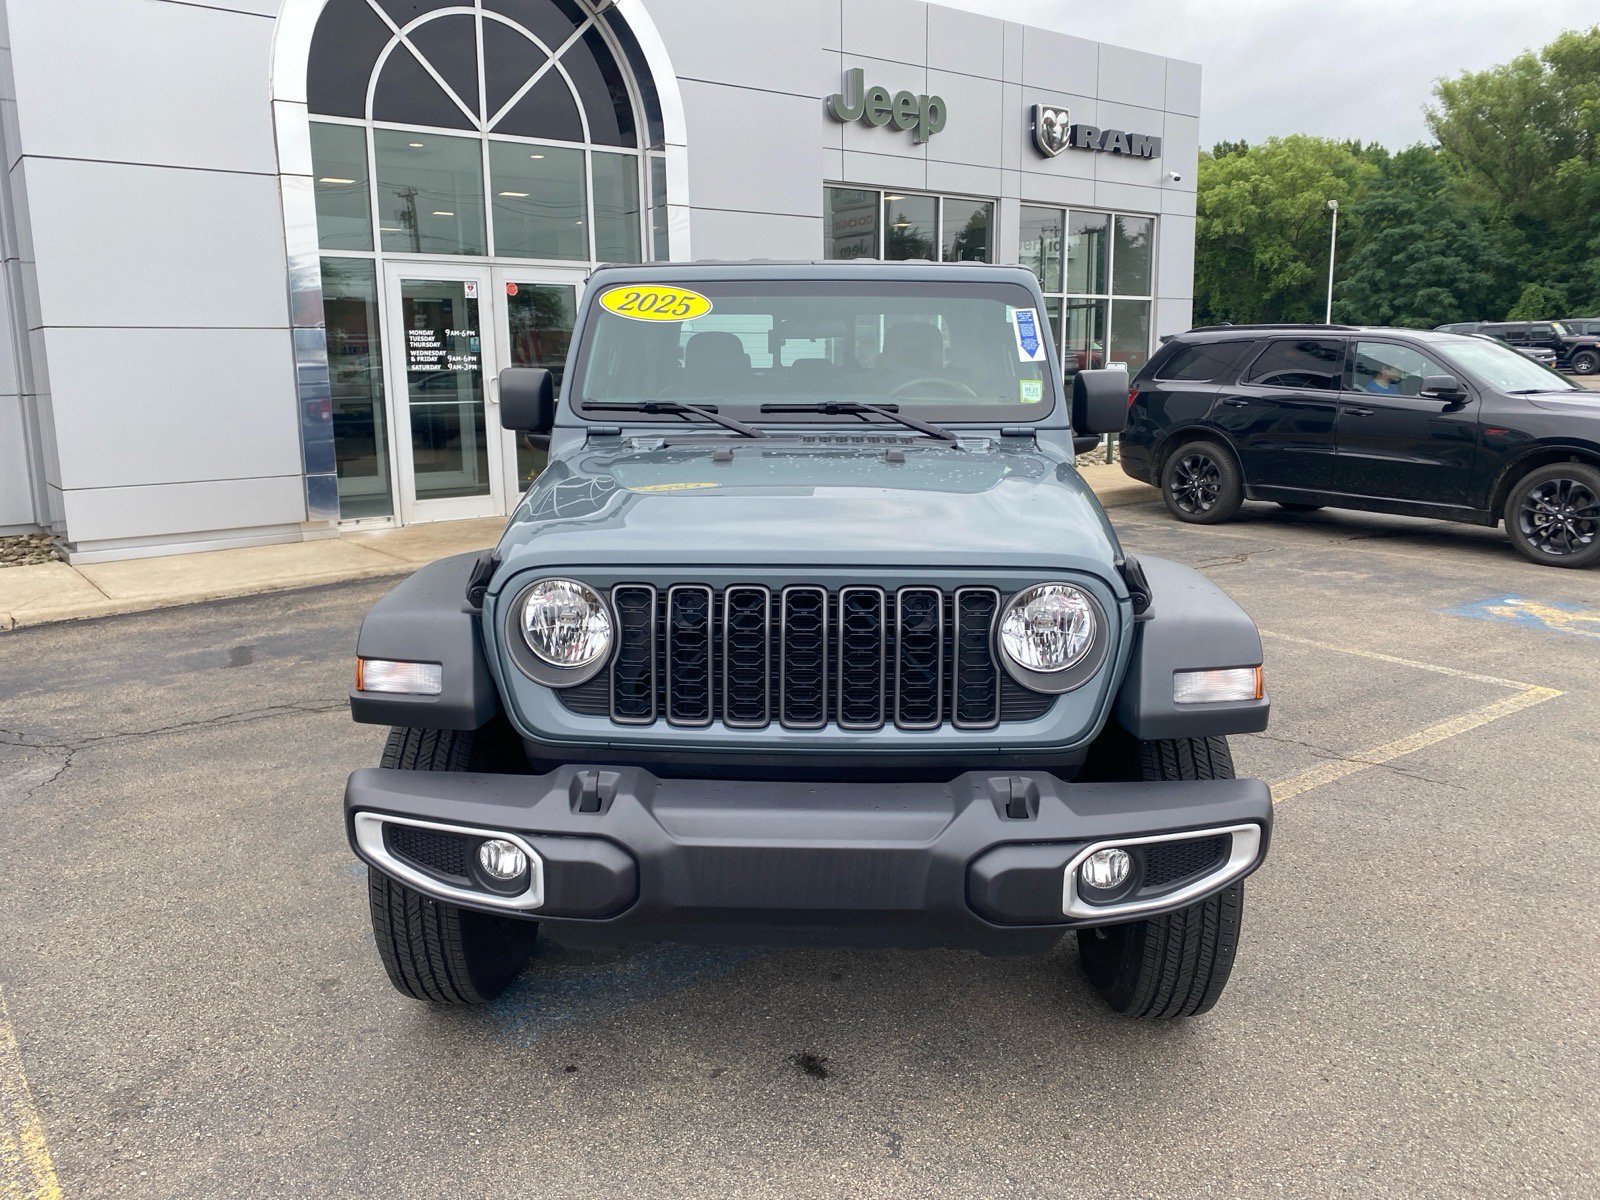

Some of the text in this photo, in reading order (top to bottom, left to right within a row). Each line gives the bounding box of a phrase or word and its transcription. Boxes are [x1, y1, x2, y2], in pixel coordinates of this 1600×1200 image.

[827, 68, 947, 144] Jeep
[1070, 124, 1162, 158] RAM
[617, 292, 696, 316] 2025
[445, 329, 476, 337] 9AM-6PM
